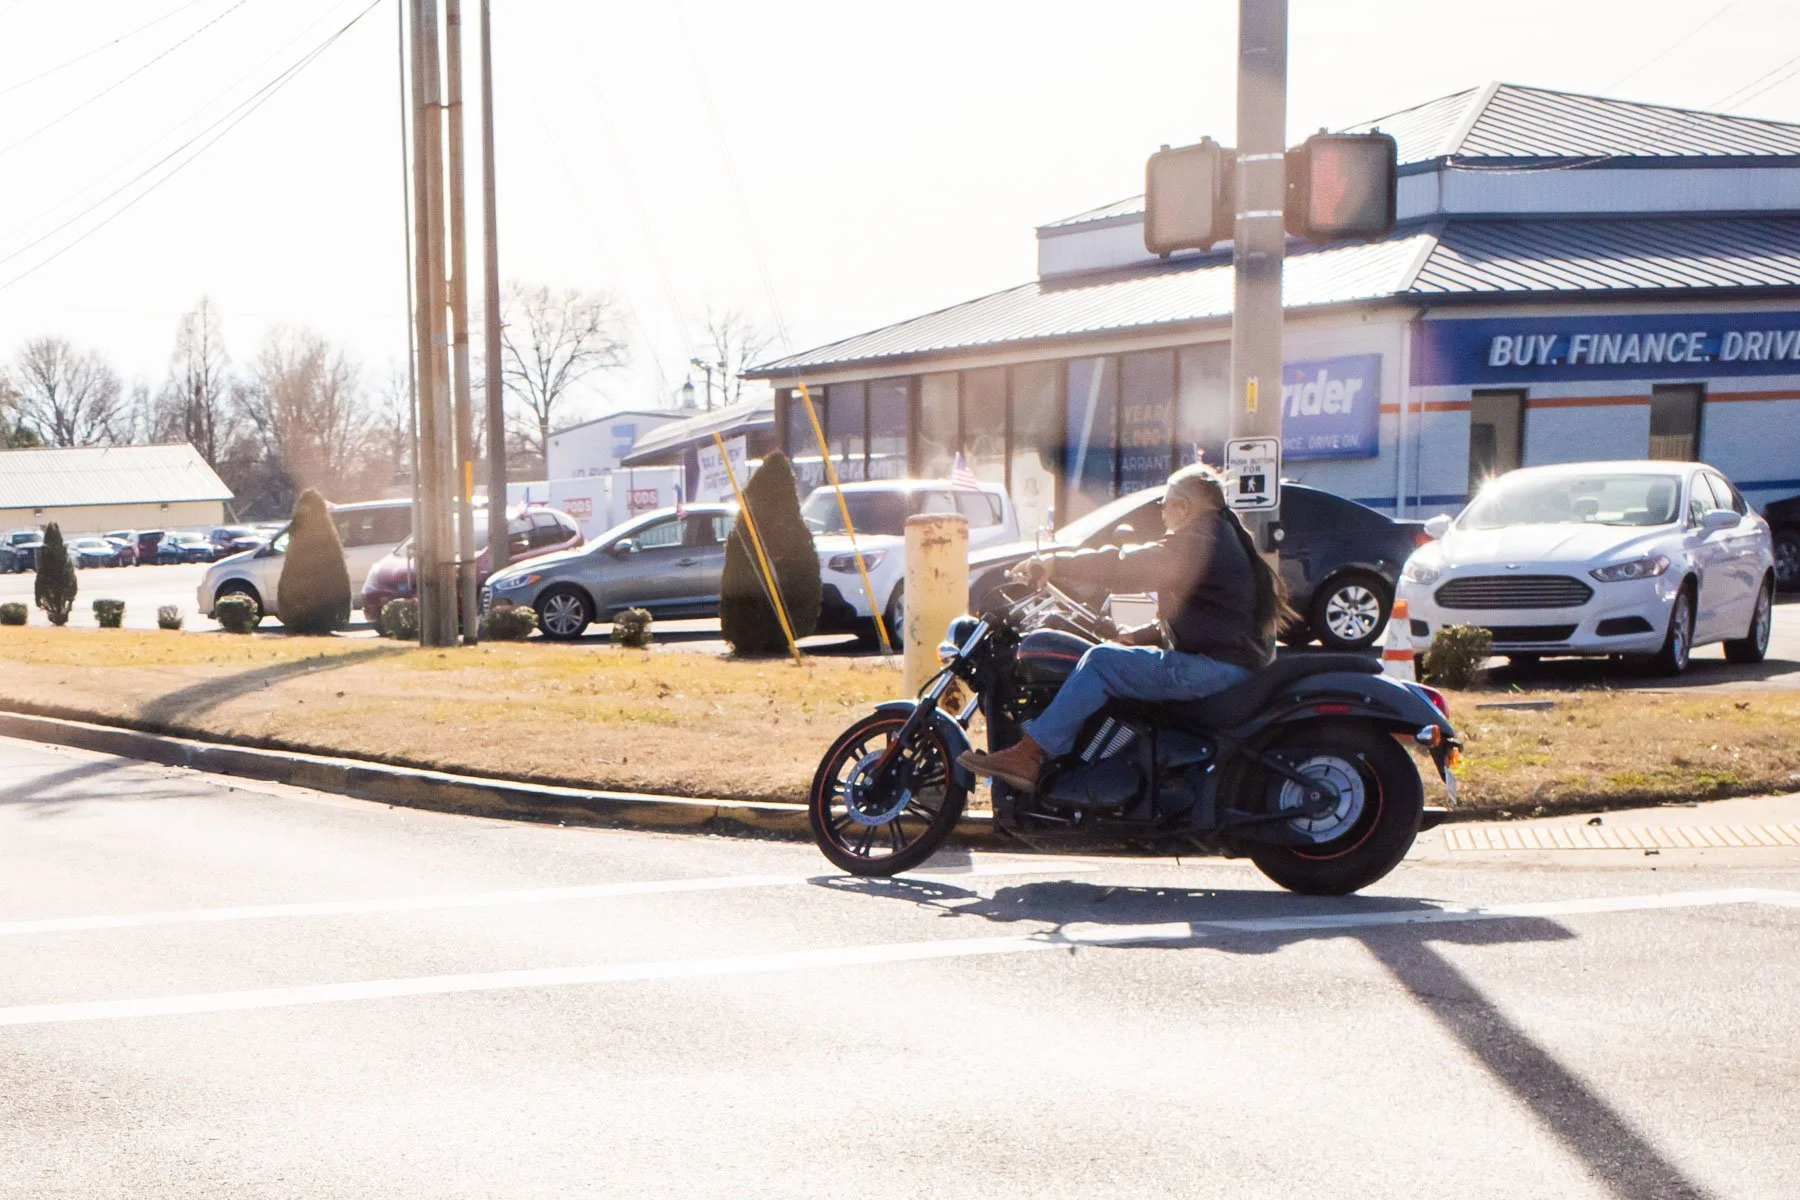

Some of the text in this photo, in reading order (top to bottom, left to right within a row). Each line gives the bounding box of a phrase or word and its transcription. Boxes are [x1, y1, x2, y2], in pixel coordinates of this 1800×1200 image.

[1489, 334, 1558, 366] BUY.
[1567, 332, 1710, 364] FINANCE.
[1230, 457, 1275, 466] PUSH BUTTON
[1243, 465, 1261, 473] FOR
